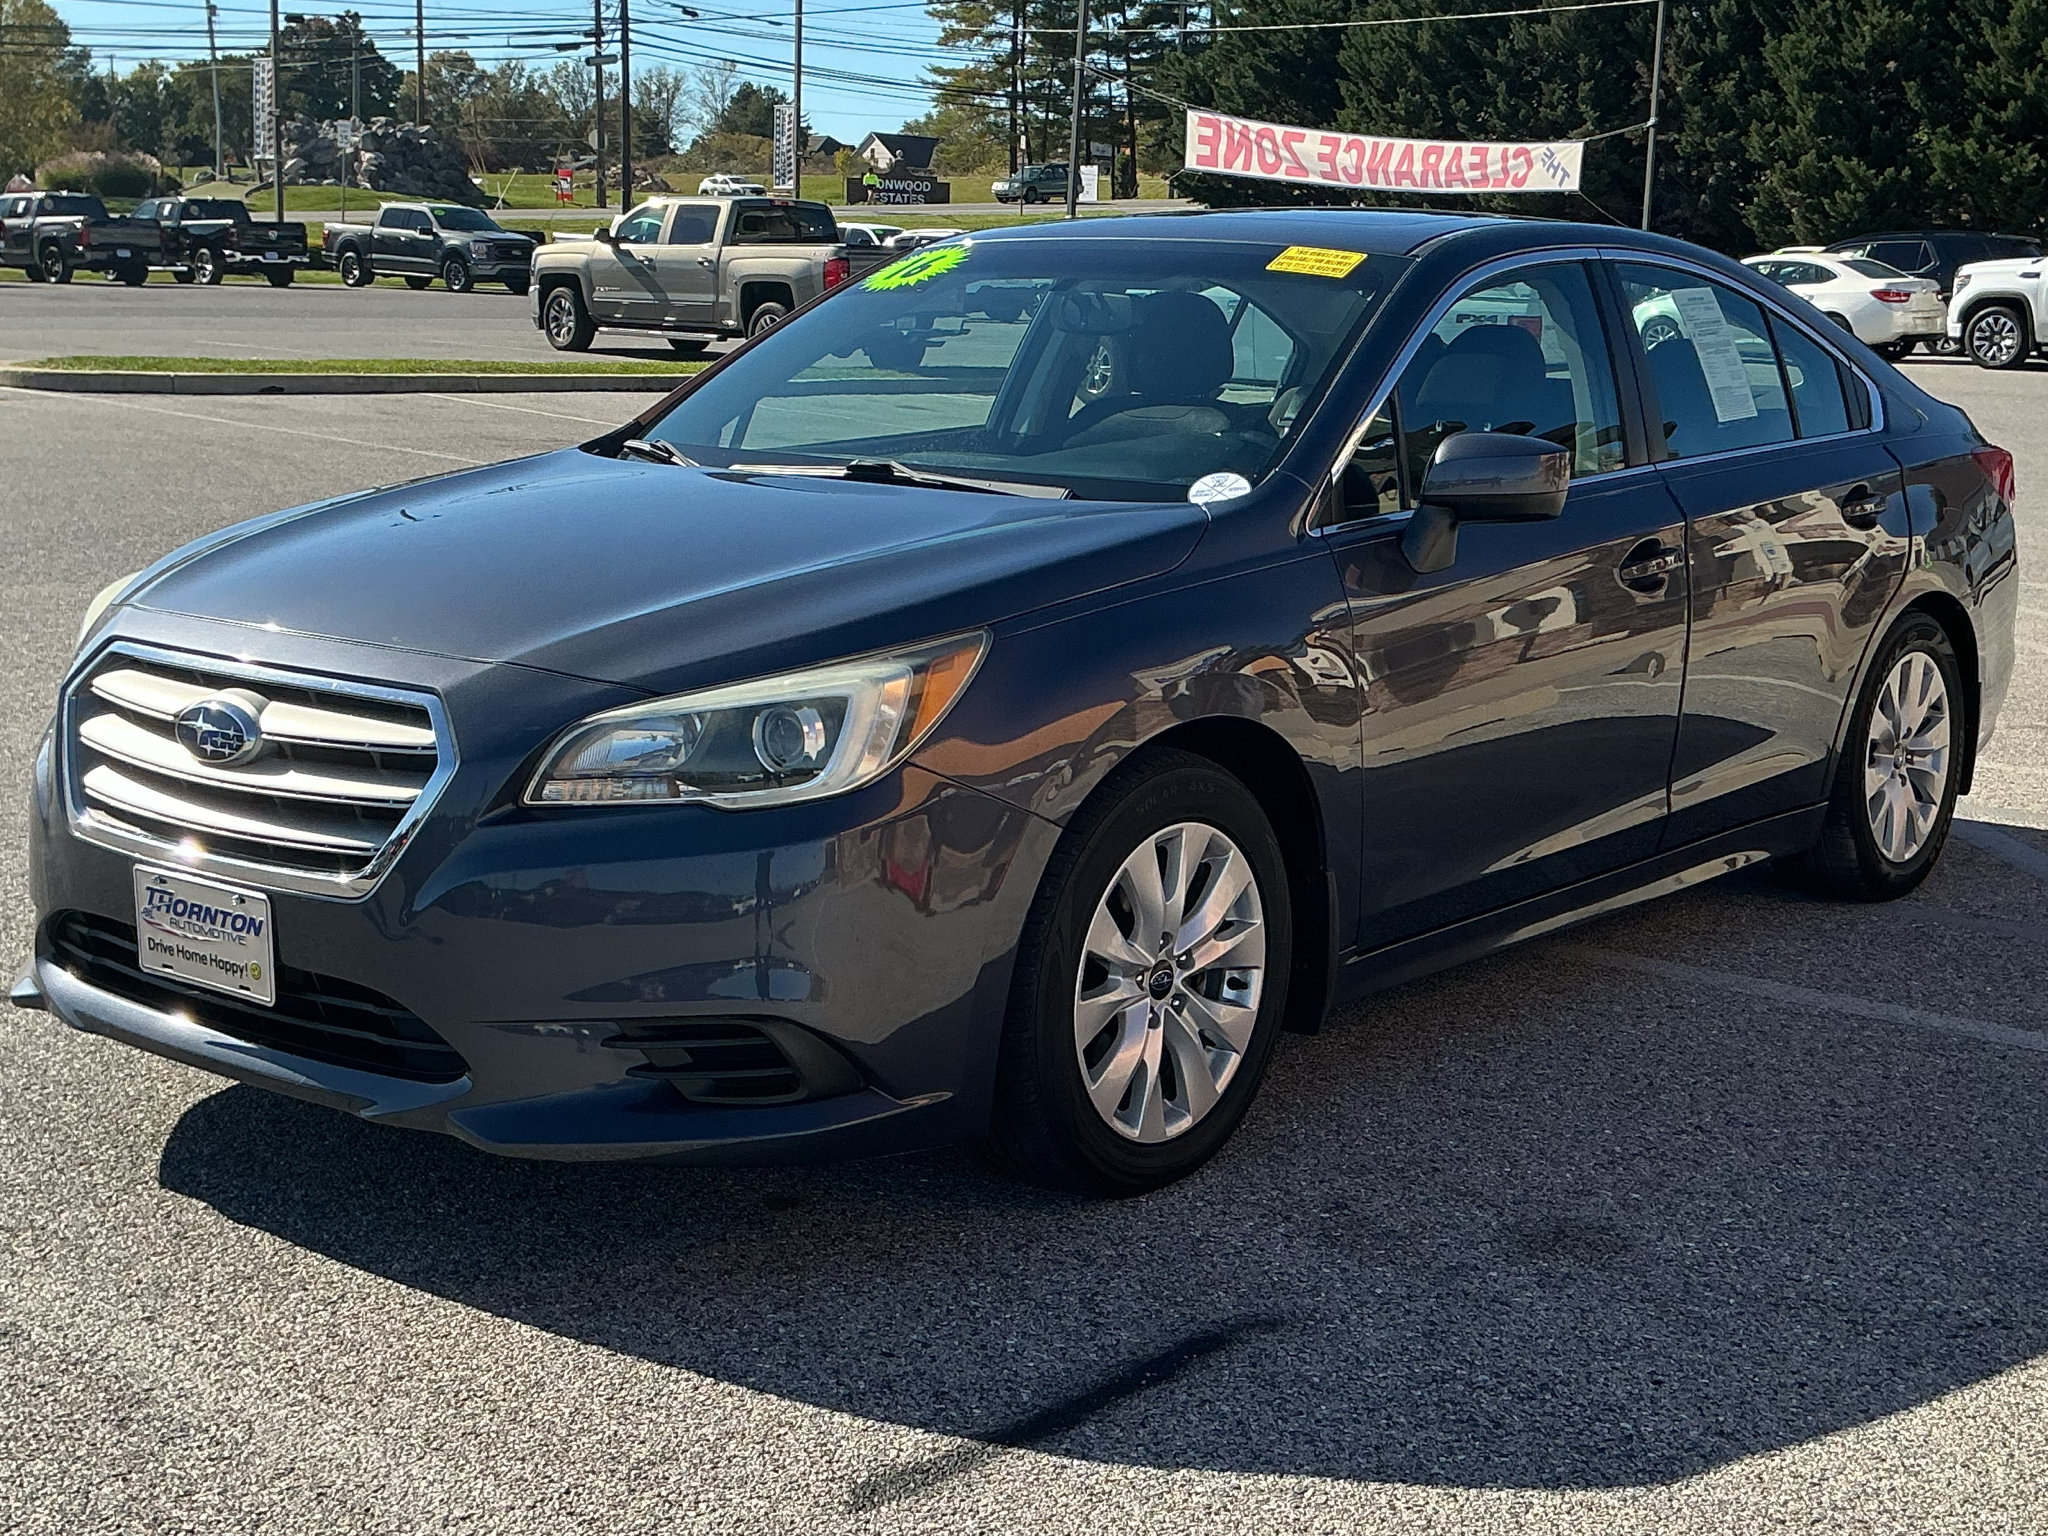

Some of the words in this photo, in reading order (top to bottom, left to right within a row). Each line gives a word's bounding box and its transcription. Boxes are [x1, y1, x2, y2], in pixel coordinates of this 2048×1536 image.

[873, 192, 925, 205] ESTATES
[1456, 314, 1498, 324] FX4
[145, 886, 264, 936] THORNTON
[168, 917, 247, 946] AUTOMOTIVE
[147, 936, 175, 957] Drive
[176, 943, 208, 966] Home
[209, 952, 249, 979] Happy!
